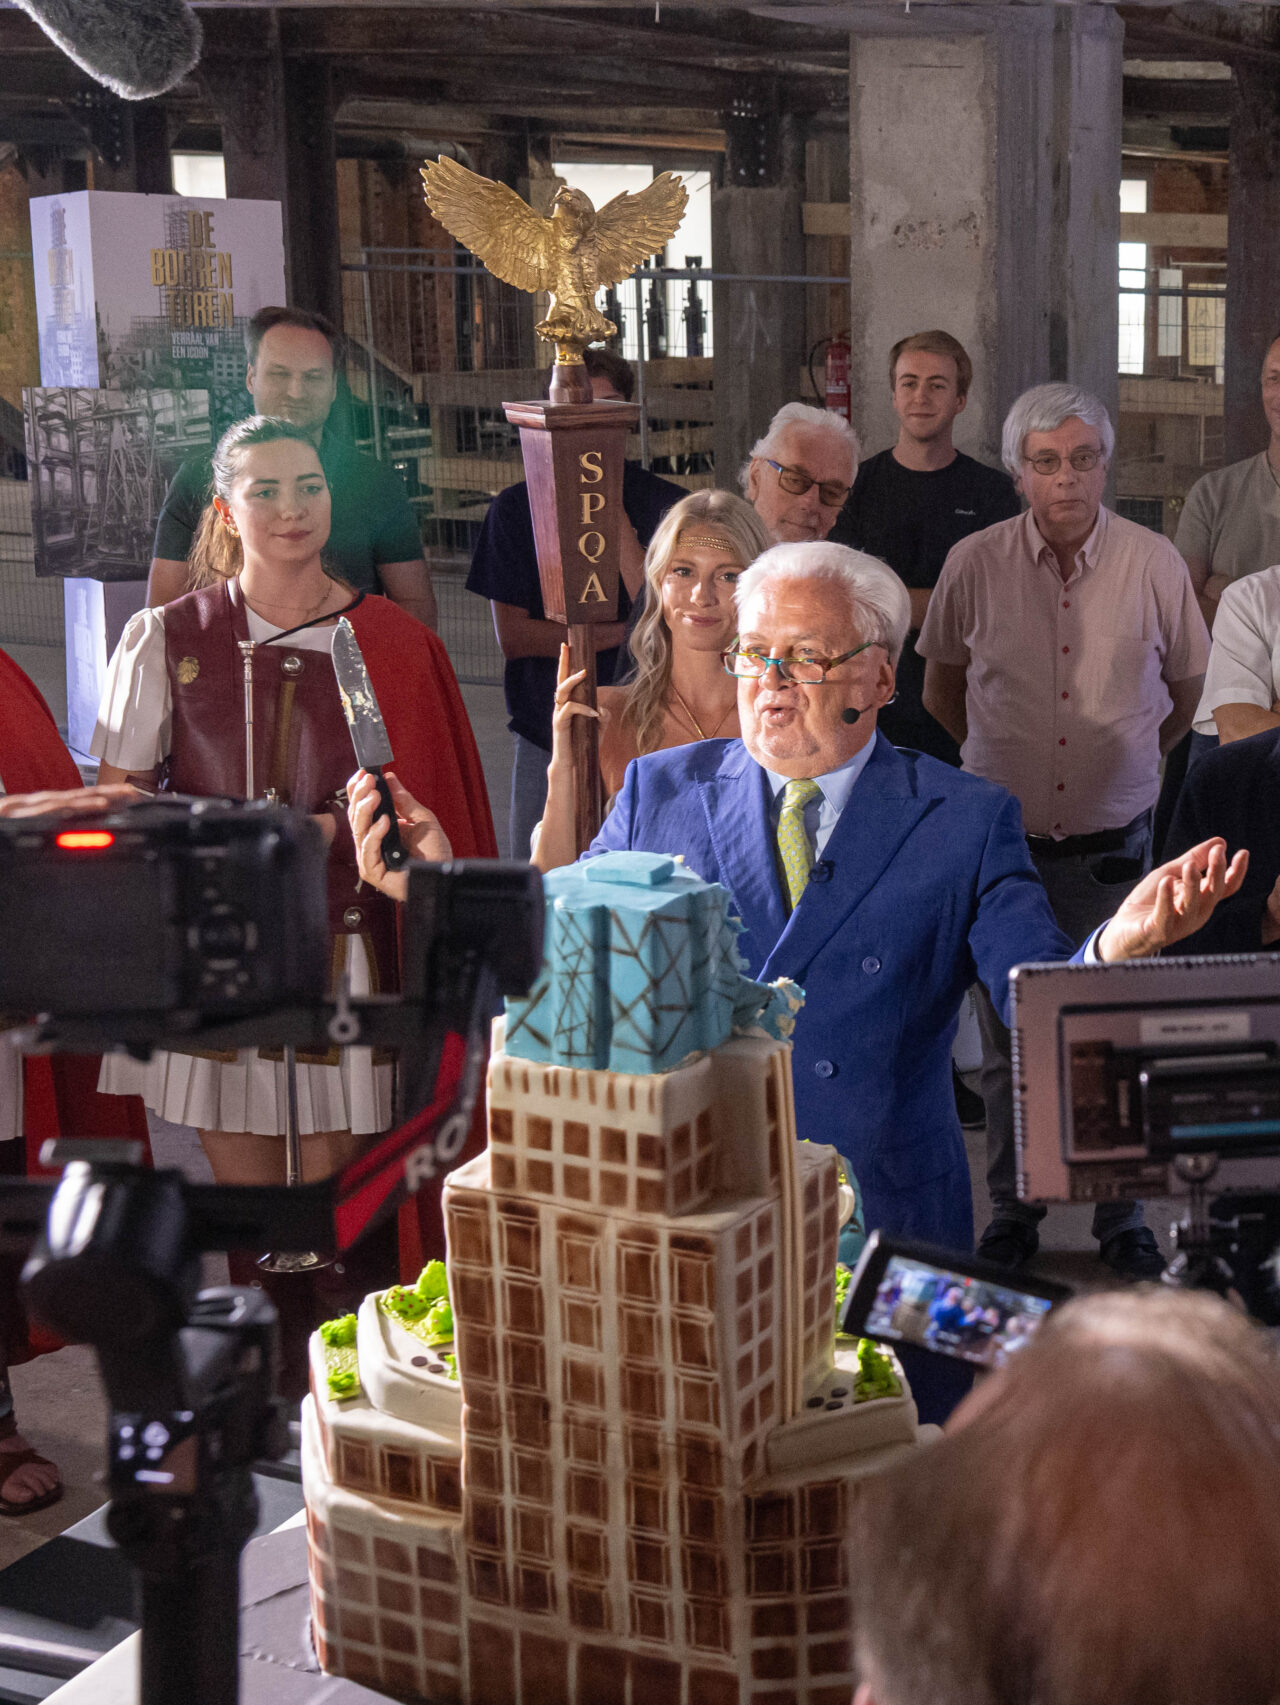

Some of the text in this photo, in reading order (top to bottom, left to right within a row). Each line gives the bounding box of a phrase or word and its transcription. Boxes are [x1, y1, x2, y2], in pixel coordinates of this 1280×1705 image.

[188, 210, 216, 248] DE
[166, 290, 234, 330] TOREN
[172, 346, 186, 358] EEN
[578, 451, 609, 604] SPQA
